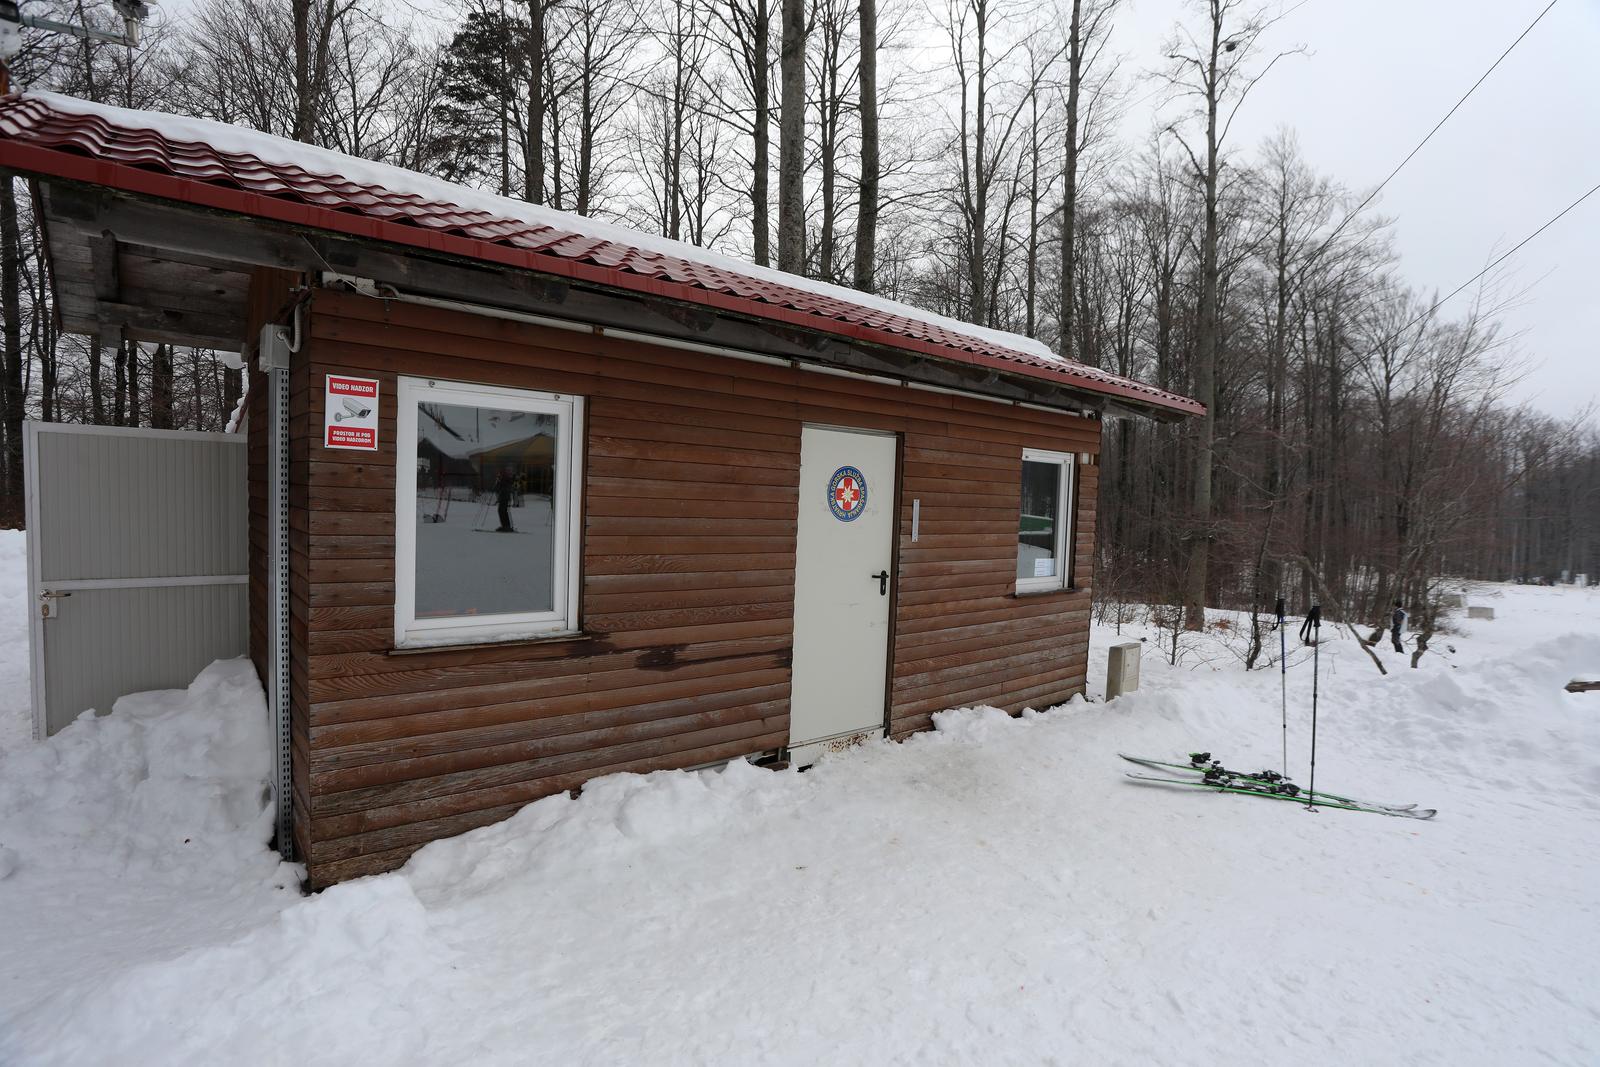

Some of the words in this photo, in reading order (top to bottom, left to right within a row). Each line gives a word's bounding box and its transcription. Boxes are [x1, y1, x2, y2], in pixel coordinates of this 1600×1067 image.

[332, 382, 350, 390] VIDEO
[351, 384, 374, 393] NADZOR
[831, 470, 846, 491] GORSKA
